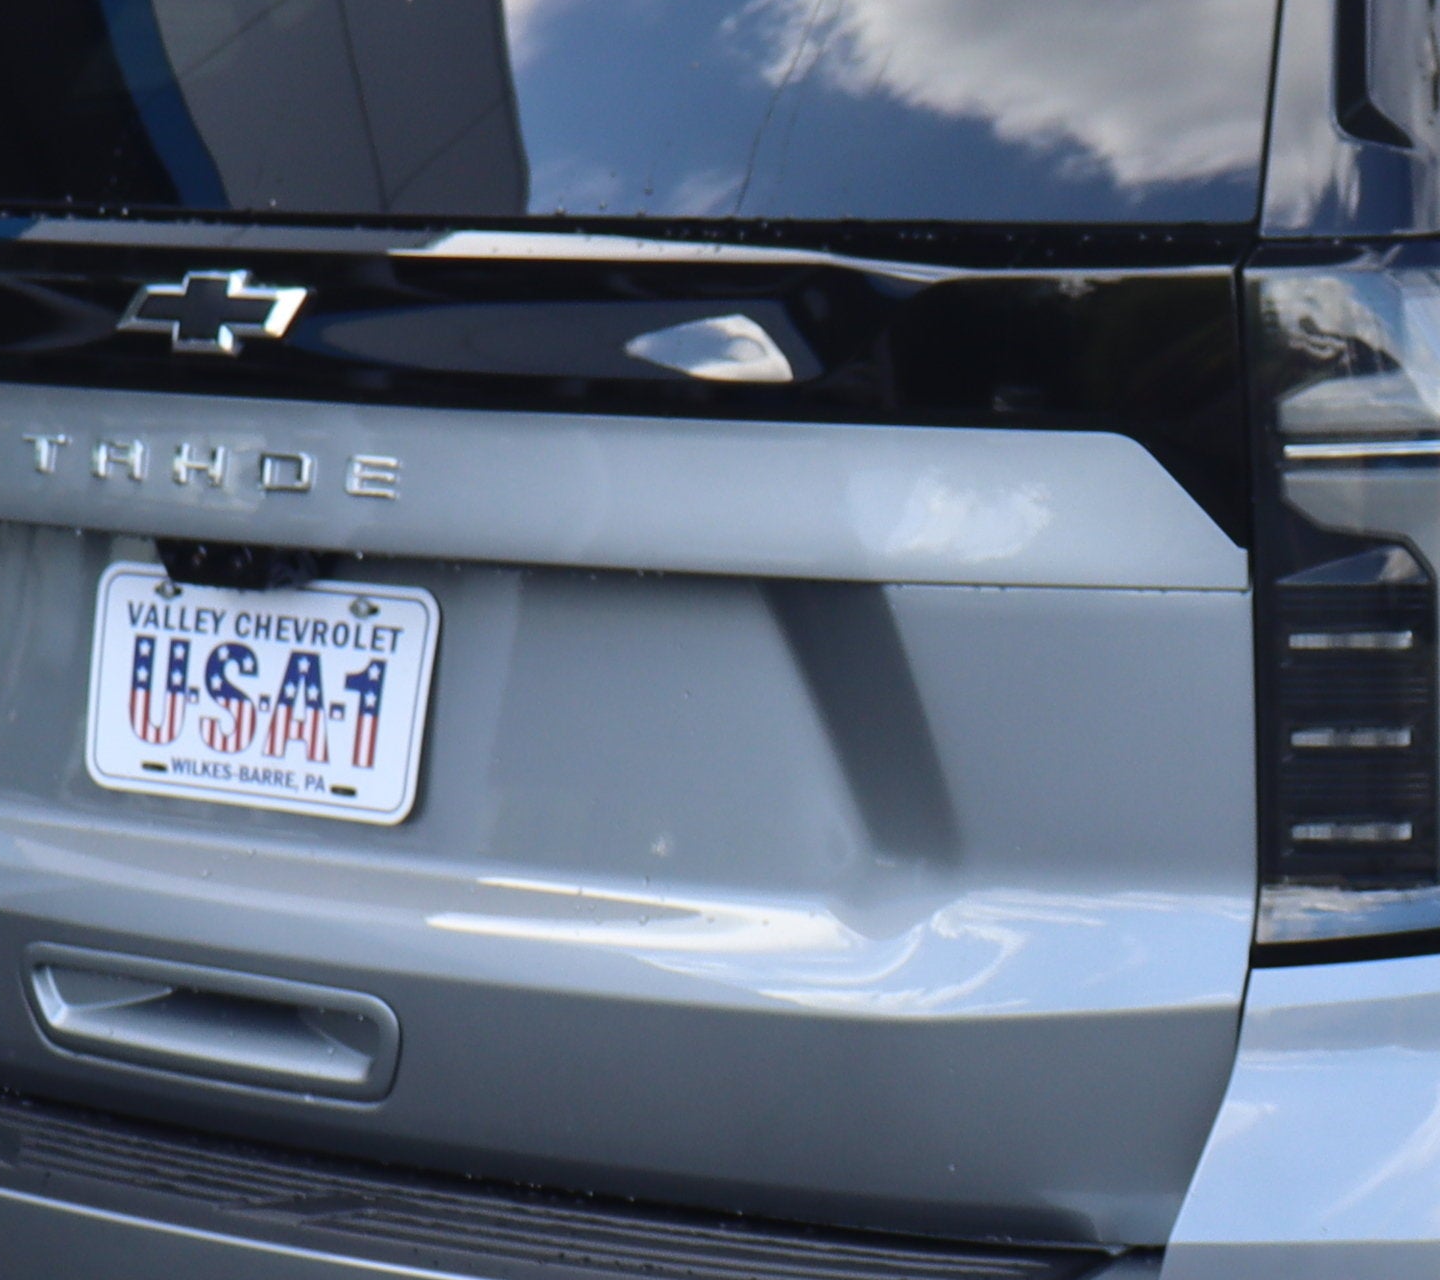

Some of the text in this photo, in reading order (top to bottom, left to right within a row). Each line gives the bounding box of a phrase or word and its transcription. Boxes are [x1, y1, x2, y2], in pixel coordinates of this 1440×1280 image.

[22, 433, 401, 499] TAHOE
[128, 601, 404, 654] VALLEY CHEVROLET
[171, 757, 326, 794] WILKES-BARRE, PA
